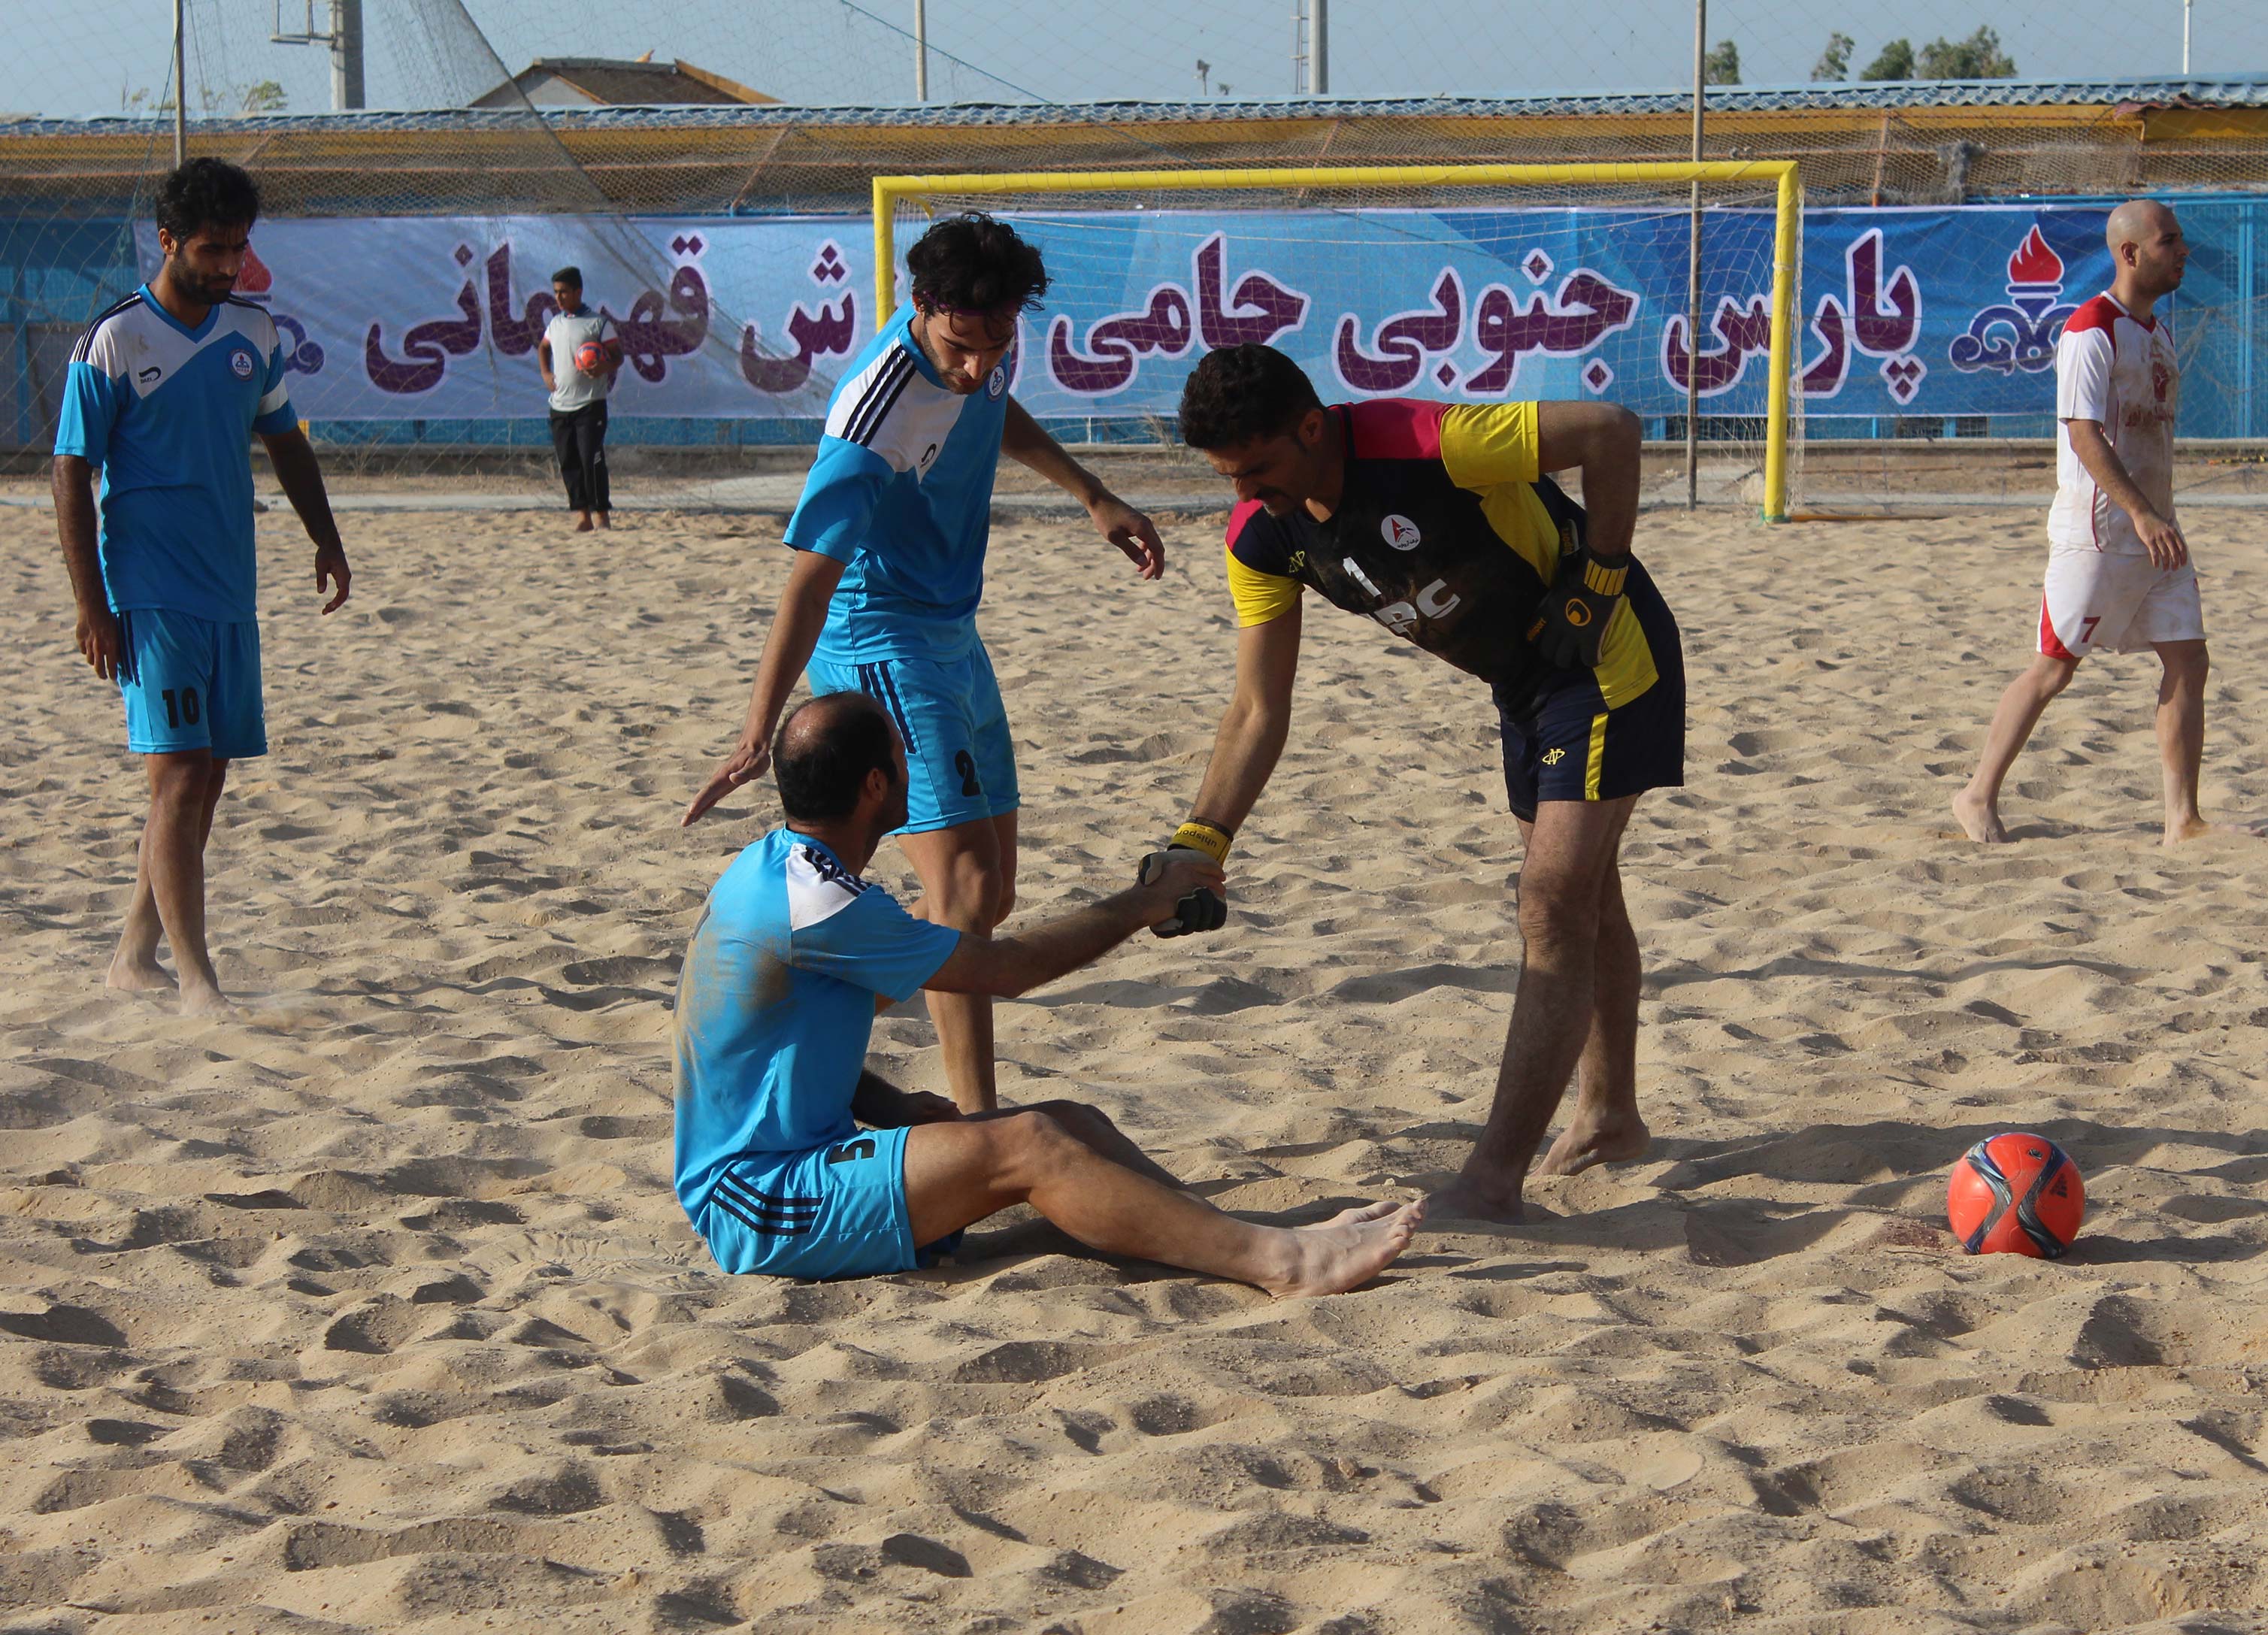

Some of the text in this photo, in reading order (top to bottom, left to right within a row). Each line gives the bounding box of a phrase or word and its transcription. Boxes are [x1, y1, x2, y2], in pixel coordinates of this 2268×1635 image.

[1051, 235, 1307, 392] حامی
[1337, 254, 1636, 392] جنوبی
[1666, 232, 1922, 400] پارس
[1343, 556, 1382, 598] 1
[1359, 577, 1461, 634] PC
[2081, 616, 2102, 644] 7
[162, 686, 201, 729] 10
[954, 749, 981, 798] 2
[1175, 828, 1218, 848] uhlspor
[828, 1138, 877, 1164] 5
